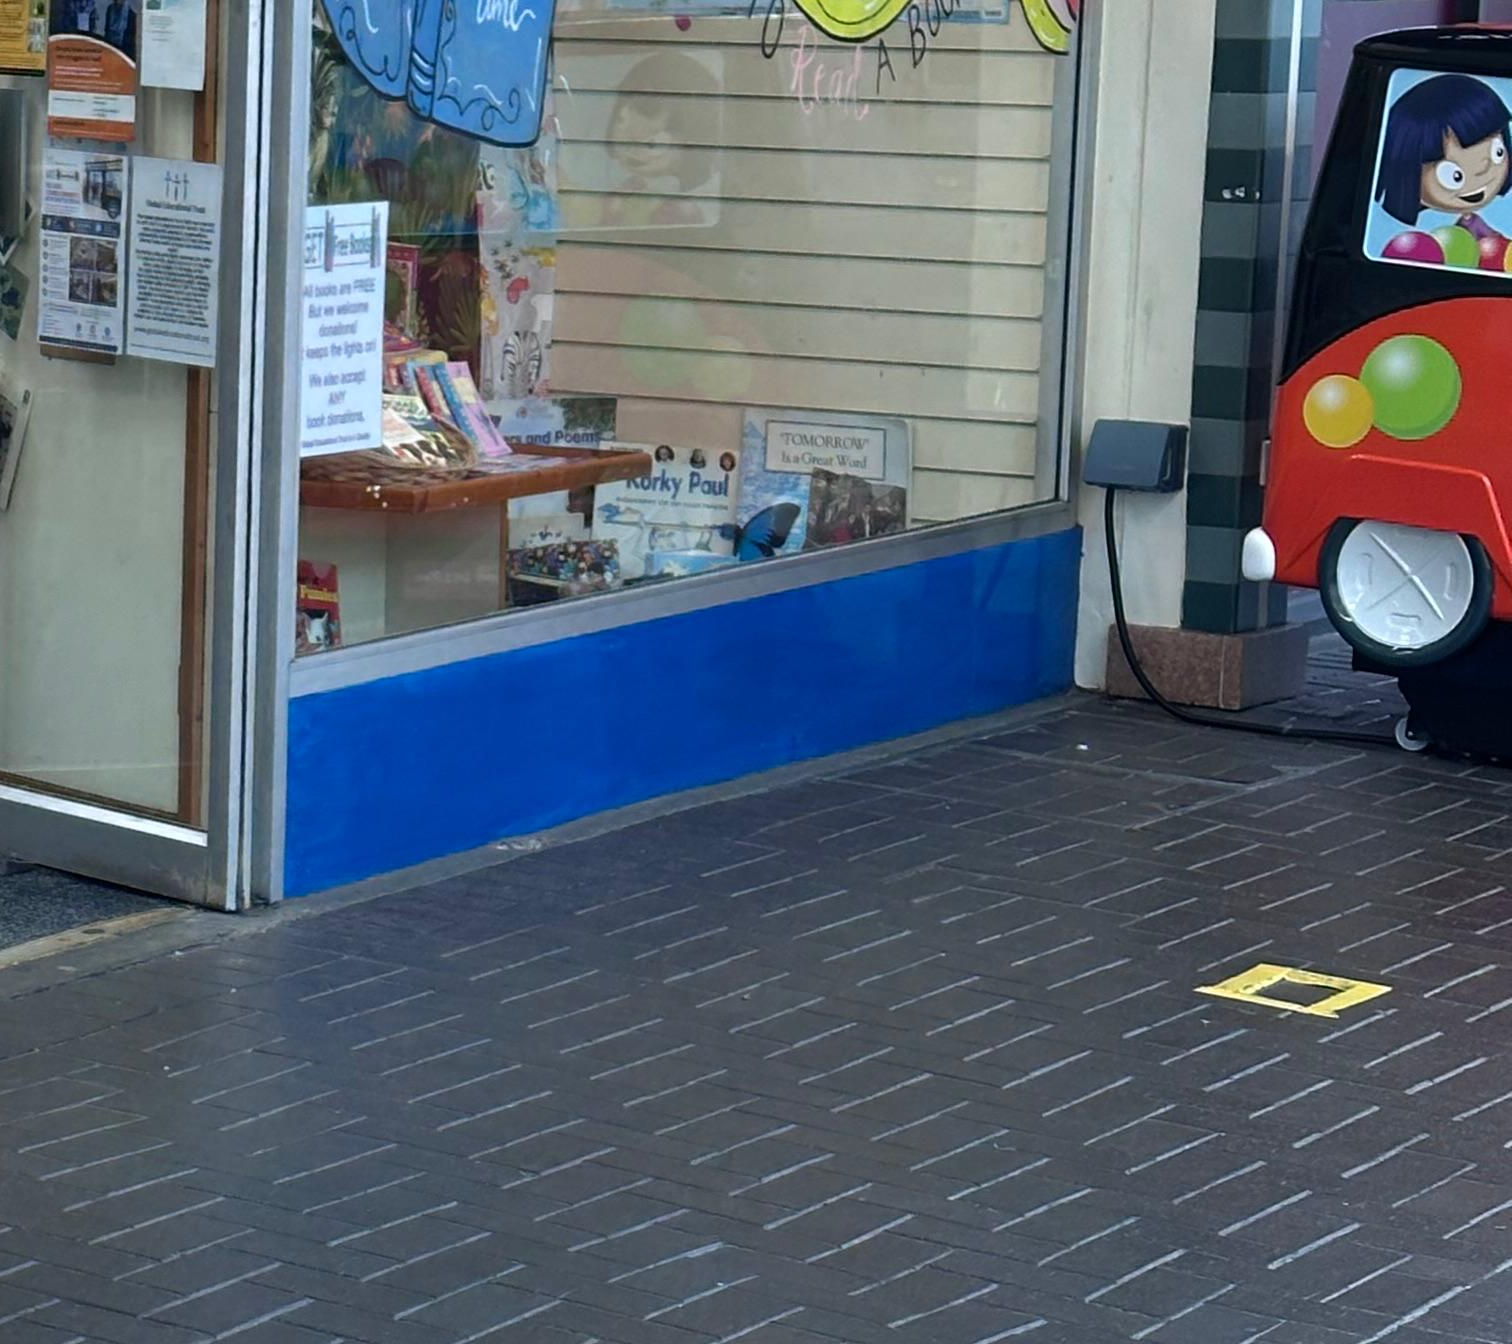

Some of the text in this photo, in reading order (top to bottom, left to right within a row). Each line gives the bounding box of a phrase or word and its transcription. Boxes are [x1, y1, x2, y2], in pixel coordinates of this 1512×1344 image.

[790, 24, 870, 121] Read
[876, 37, 896, 96] A
[314, 283, 338, 298] books
[339, 283, 351, 295] are
[308, 301, 369, 319] But we welcome
[306, 341, 363, 359] keeps the lights
[309, 369, 365, 388] We also accept
[328, 390, 346, 405] ANY
[306, 414, 326, 429] book
[524, 429, 602, 444] and Poems
[801, 452, 833, 467] Great
[837, 455, 868, 470] Word
[626, 468, 729, 500] Korky Paul
